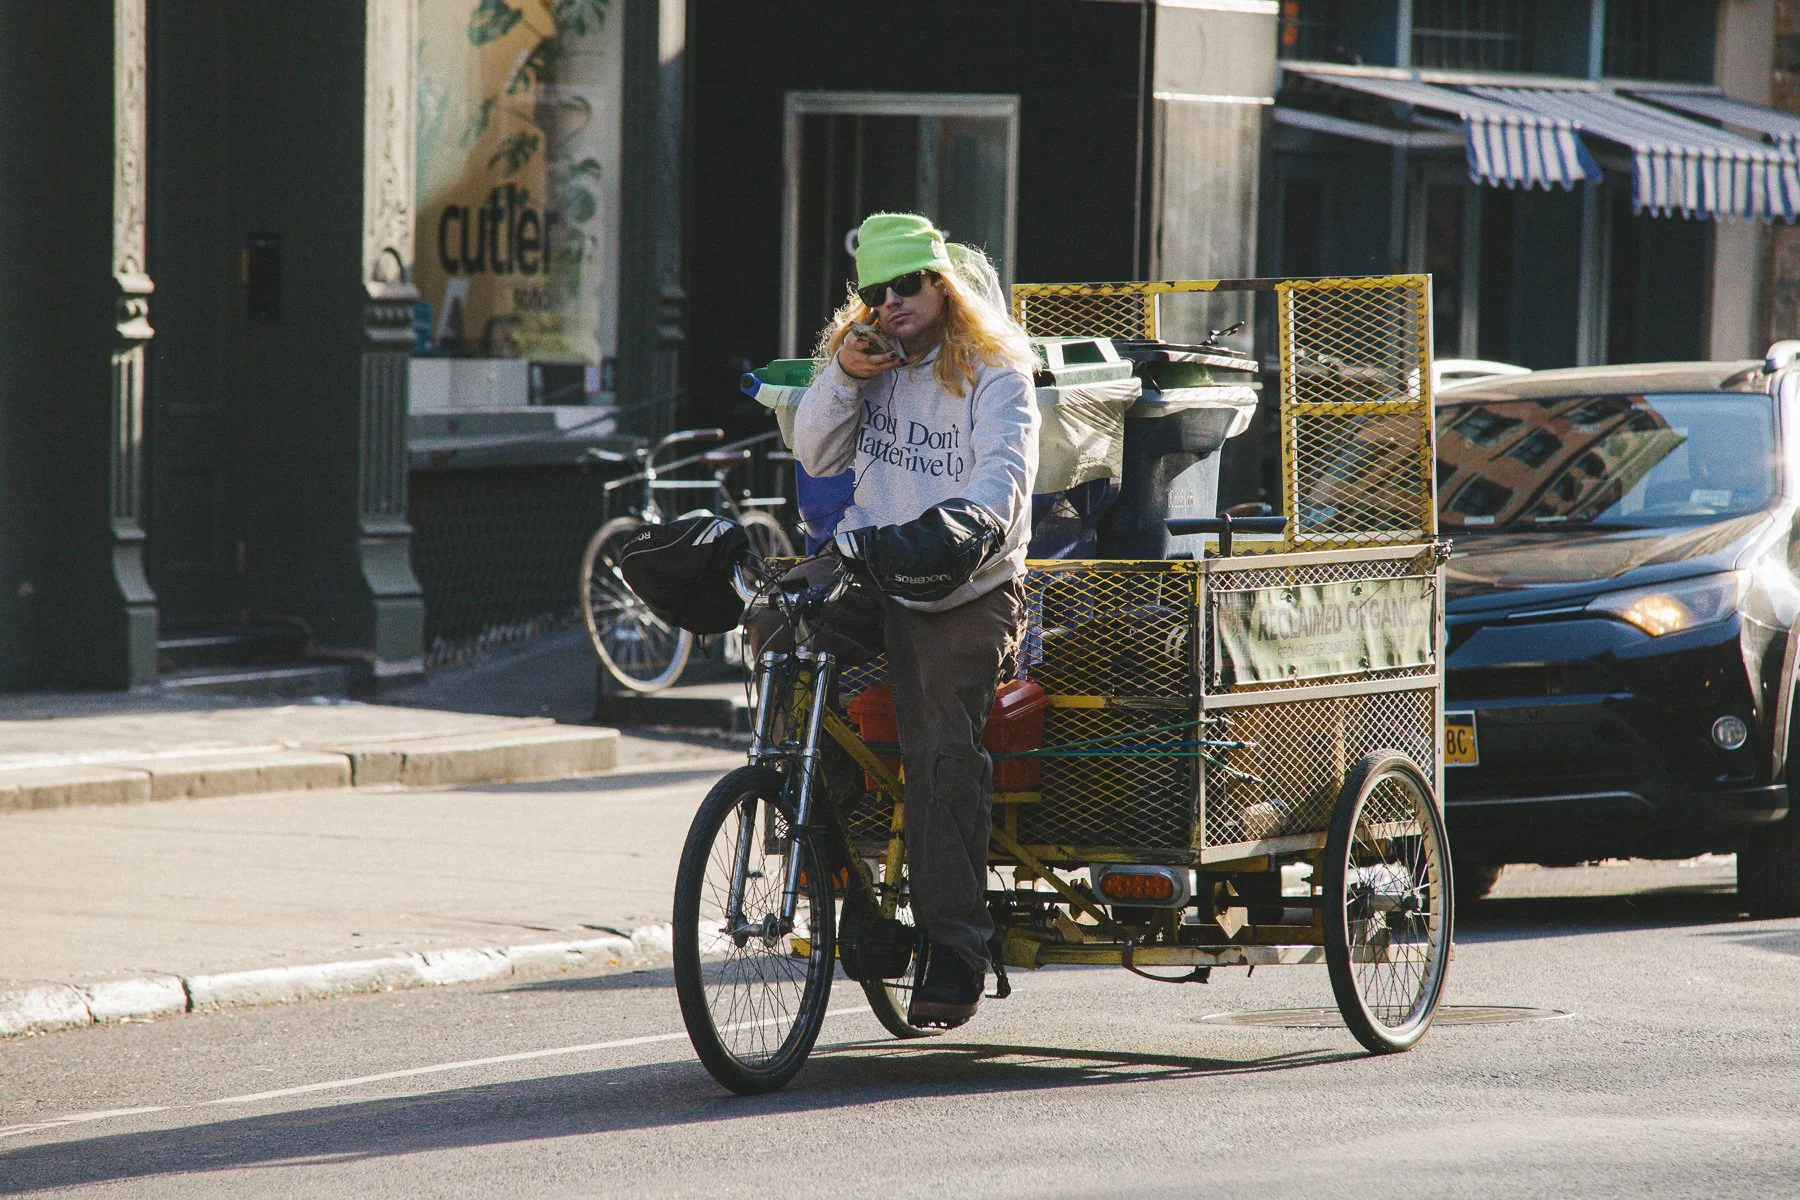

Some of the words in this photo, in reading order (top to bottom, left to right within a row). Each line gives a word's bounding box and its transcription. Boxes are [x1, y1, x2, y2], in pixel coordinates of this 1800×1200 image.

[439, 184, 560, 275] cutler
[864, 399, 898, 435] You
[905, 420, 960, 450] Don't
[1258, 602, 1343, 641] RECLAIMED
[1346, 595, 1429, 633] ORGANICS
